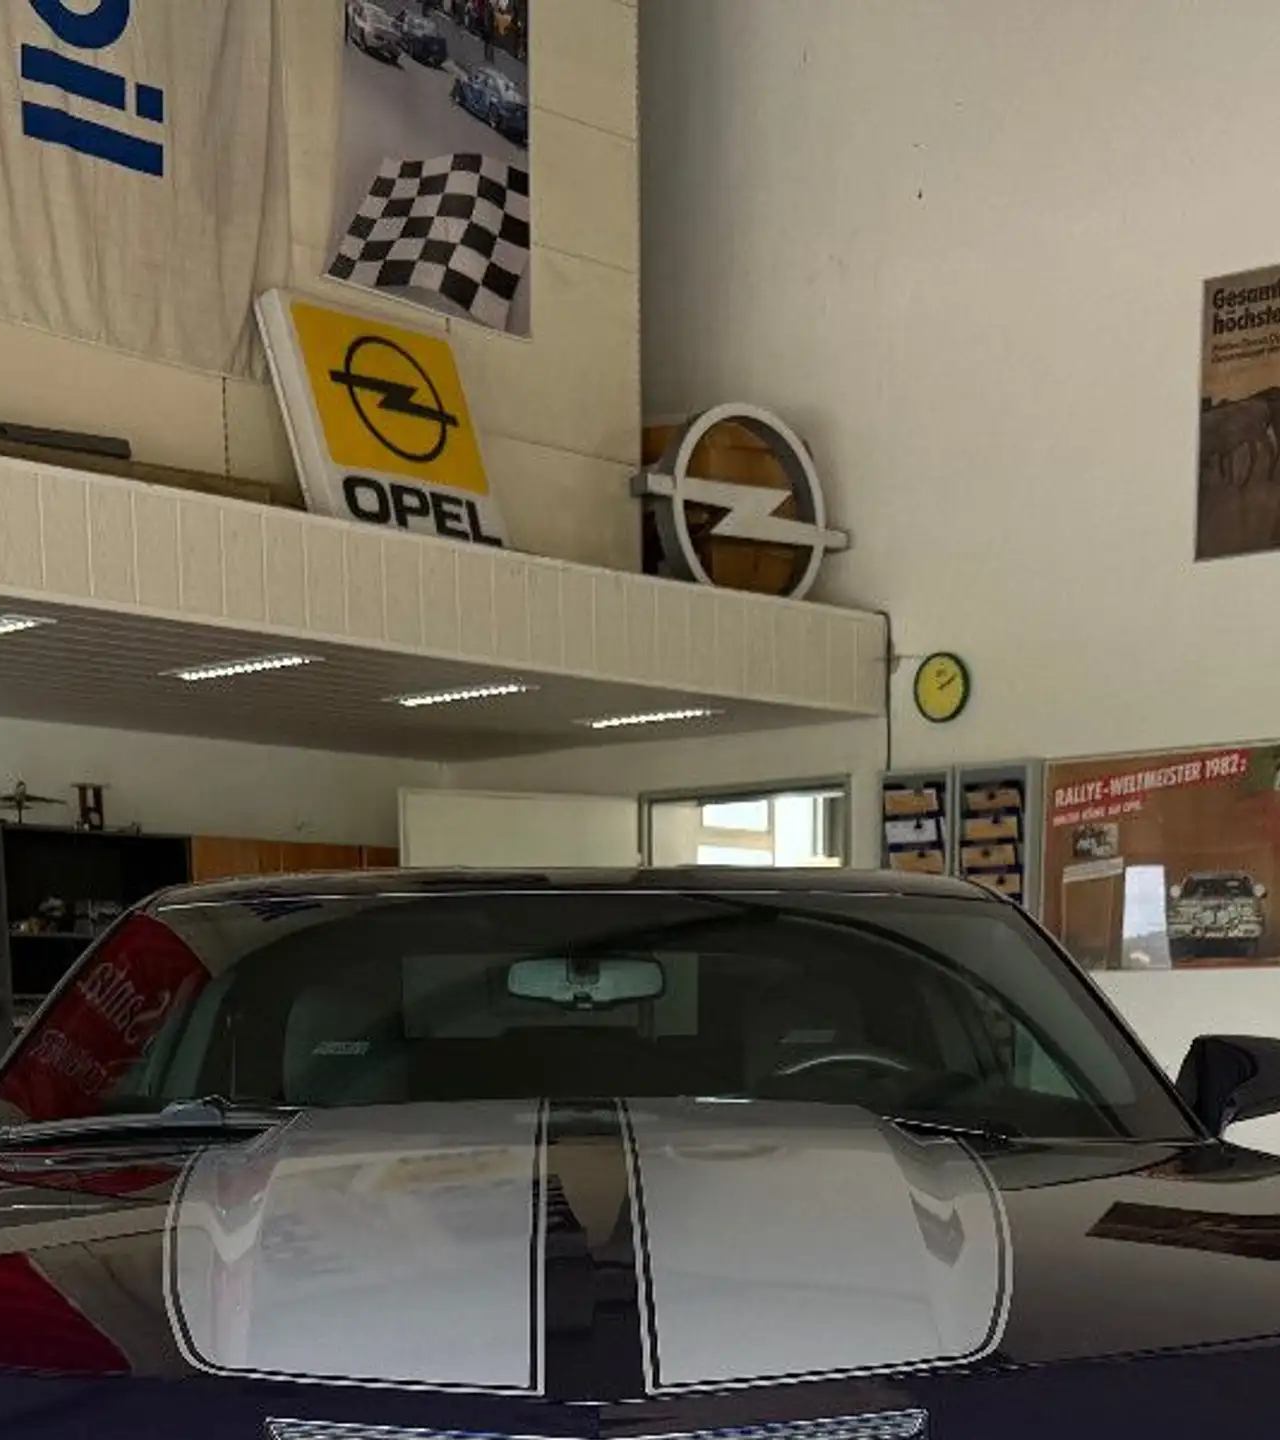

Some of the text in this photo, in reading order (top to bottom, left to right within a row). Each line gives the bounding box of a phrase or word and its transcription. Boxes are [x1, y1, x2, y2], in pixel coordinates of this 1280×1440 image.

[342, 475, 503, 548] OPEL
[1054, 753, 1248, 808] RALLYE-WELTMEISTER 1982:
